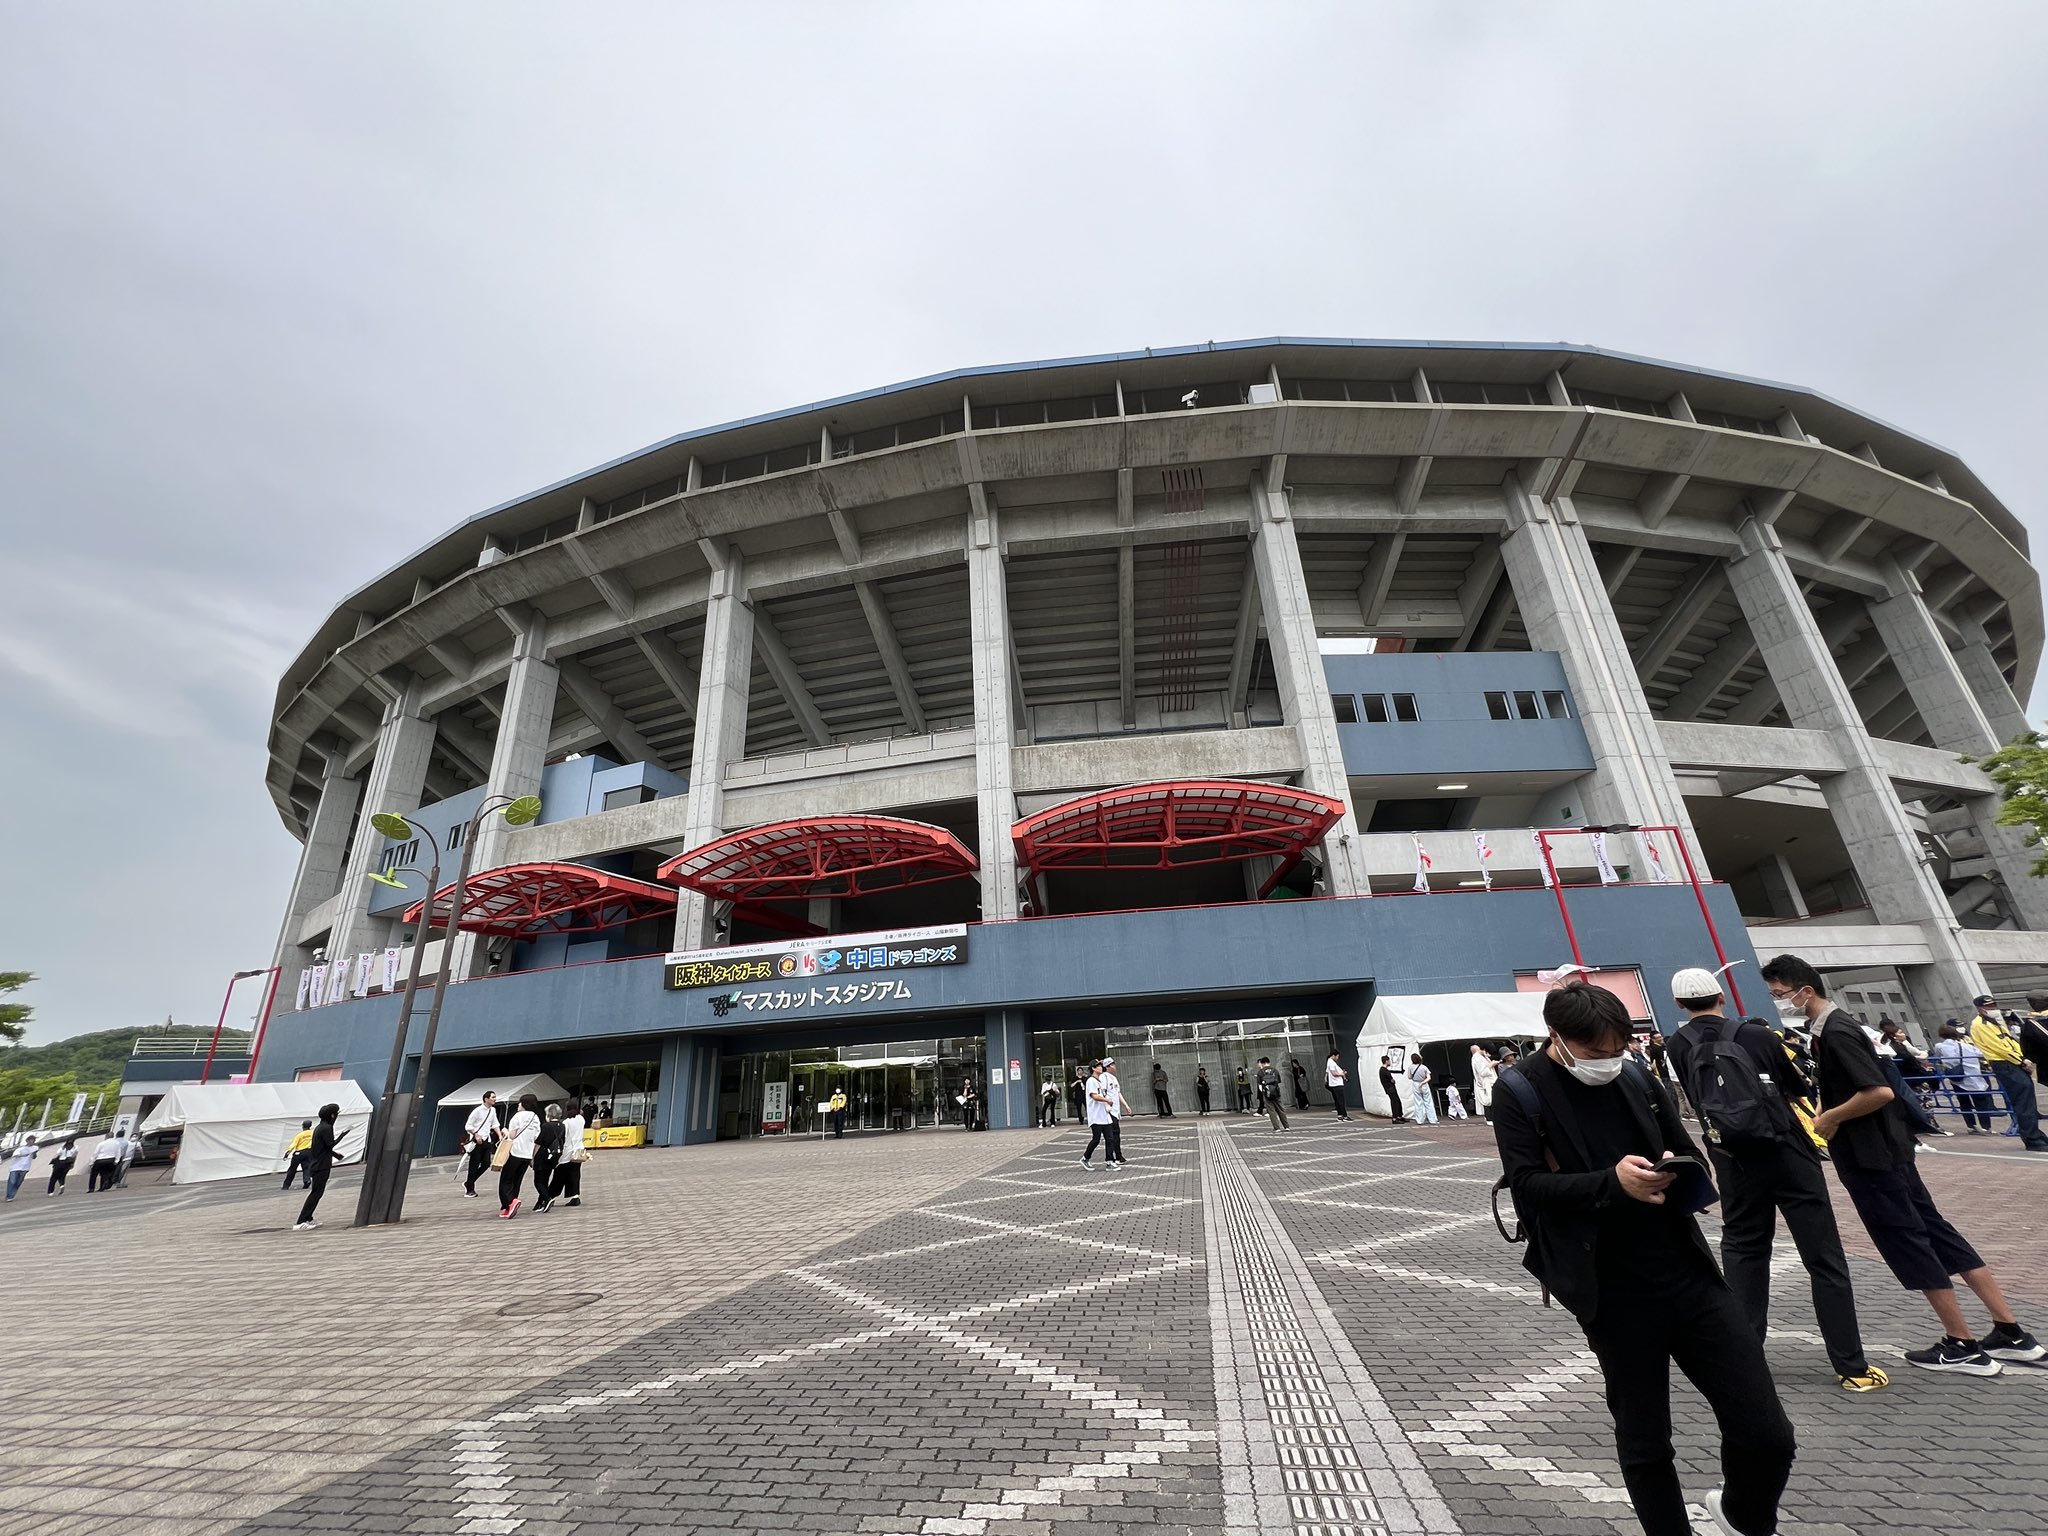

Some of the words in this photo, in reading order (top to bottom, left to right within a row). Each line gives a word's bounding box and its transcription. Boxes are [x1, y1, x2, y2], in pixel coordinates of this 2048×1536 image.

[803, 953, 817, 973] VS
[846, 945, 958, 969] 中日ドラゴンズ
[674, 962, 772, 987] 阪神タイガース
[741, 980, 912, 1011] マスカットスタジアム
